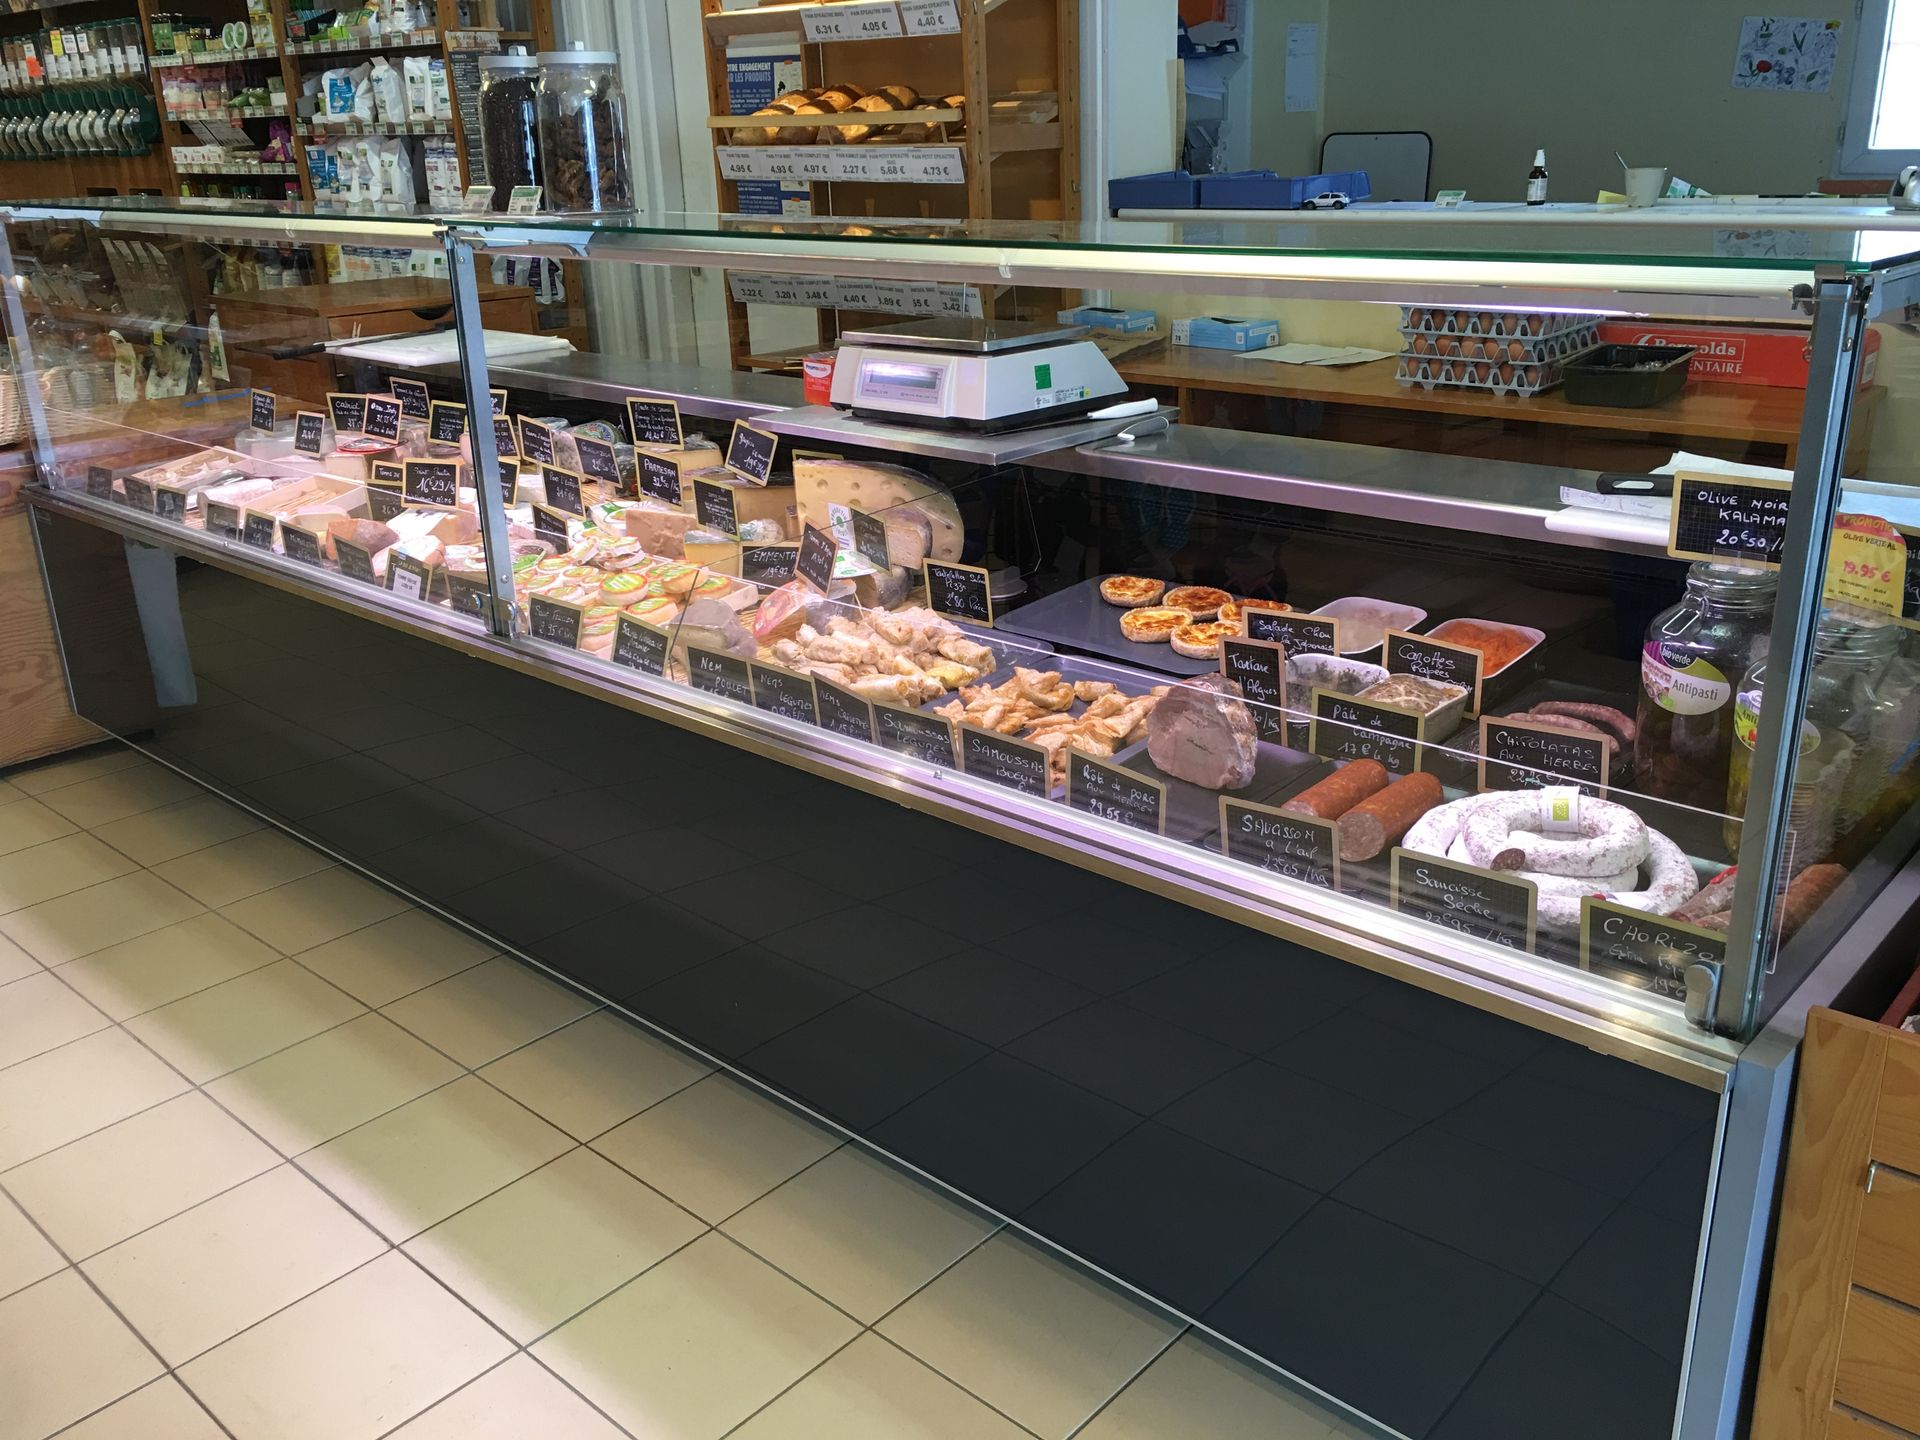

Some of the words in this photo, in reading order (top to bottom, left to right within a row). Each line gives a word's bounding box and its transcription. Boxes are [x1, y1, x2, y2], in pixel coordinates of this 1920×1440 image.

[862, 21, 880, 32] 4.05
[917, 16, 936, 27] 4.40
[815, 24, 833, 34] 6.31
[770, 165, 787, 174] 4.93
[804, 164, 820, 174] 4.97
[842, 165, 859, 174] 2.27
[922, 166, 941, 176] 4.73
[644, 458, 676, 478] PARMESAN
[1750, 499, 1790, 511] NOIR
[1719, 508, 1786, 527] KALAMA
[1843, 532, 1864, 542] OLIVE
[752, 550, 798, 562] EMMENTA
[715, 676, 750, 696] POULET
[1672, 679, 1720, 700] Antipasti
[1370, 714, 1383, 728] de
[1544, 754, 1599, 774] HERBES
[1603, 917, 1714, 962] CHORIZO
